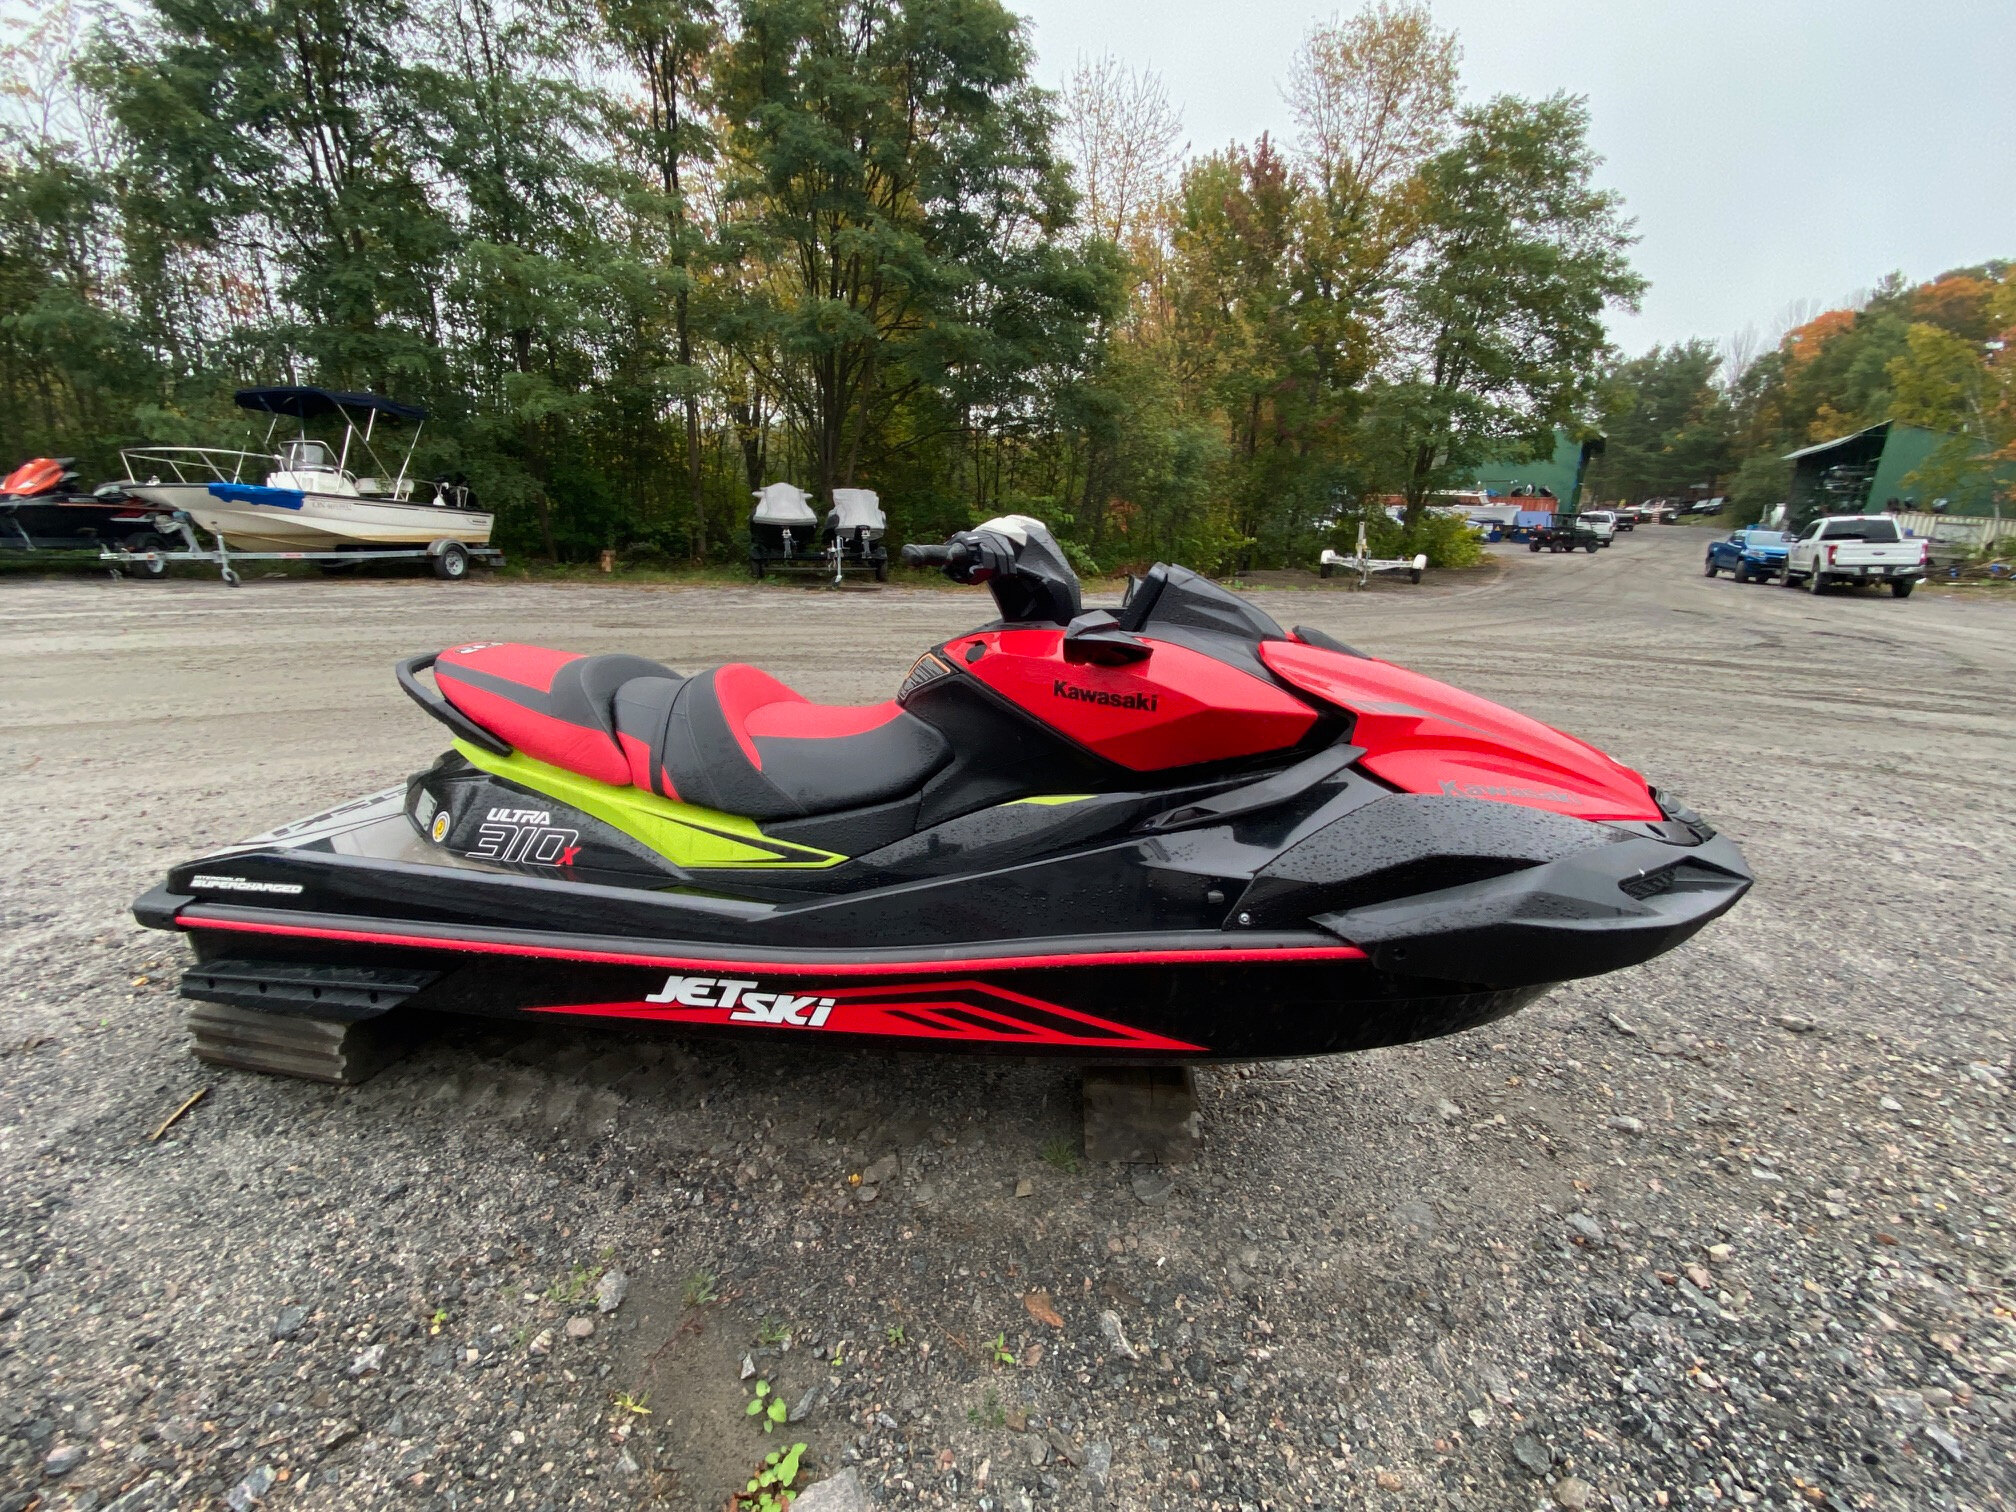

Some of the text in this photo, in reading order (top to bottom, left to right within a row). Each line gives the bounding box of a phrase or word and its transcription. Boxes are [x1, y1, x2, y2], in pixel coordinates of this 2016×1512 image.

[1053, 679, 1159, 712] Kawasaki
[486, 807, 550, 825] ULTRA
[189, 880, 304, 894] SUPERCHARGED
[645, 975, 759, 1008] JET
